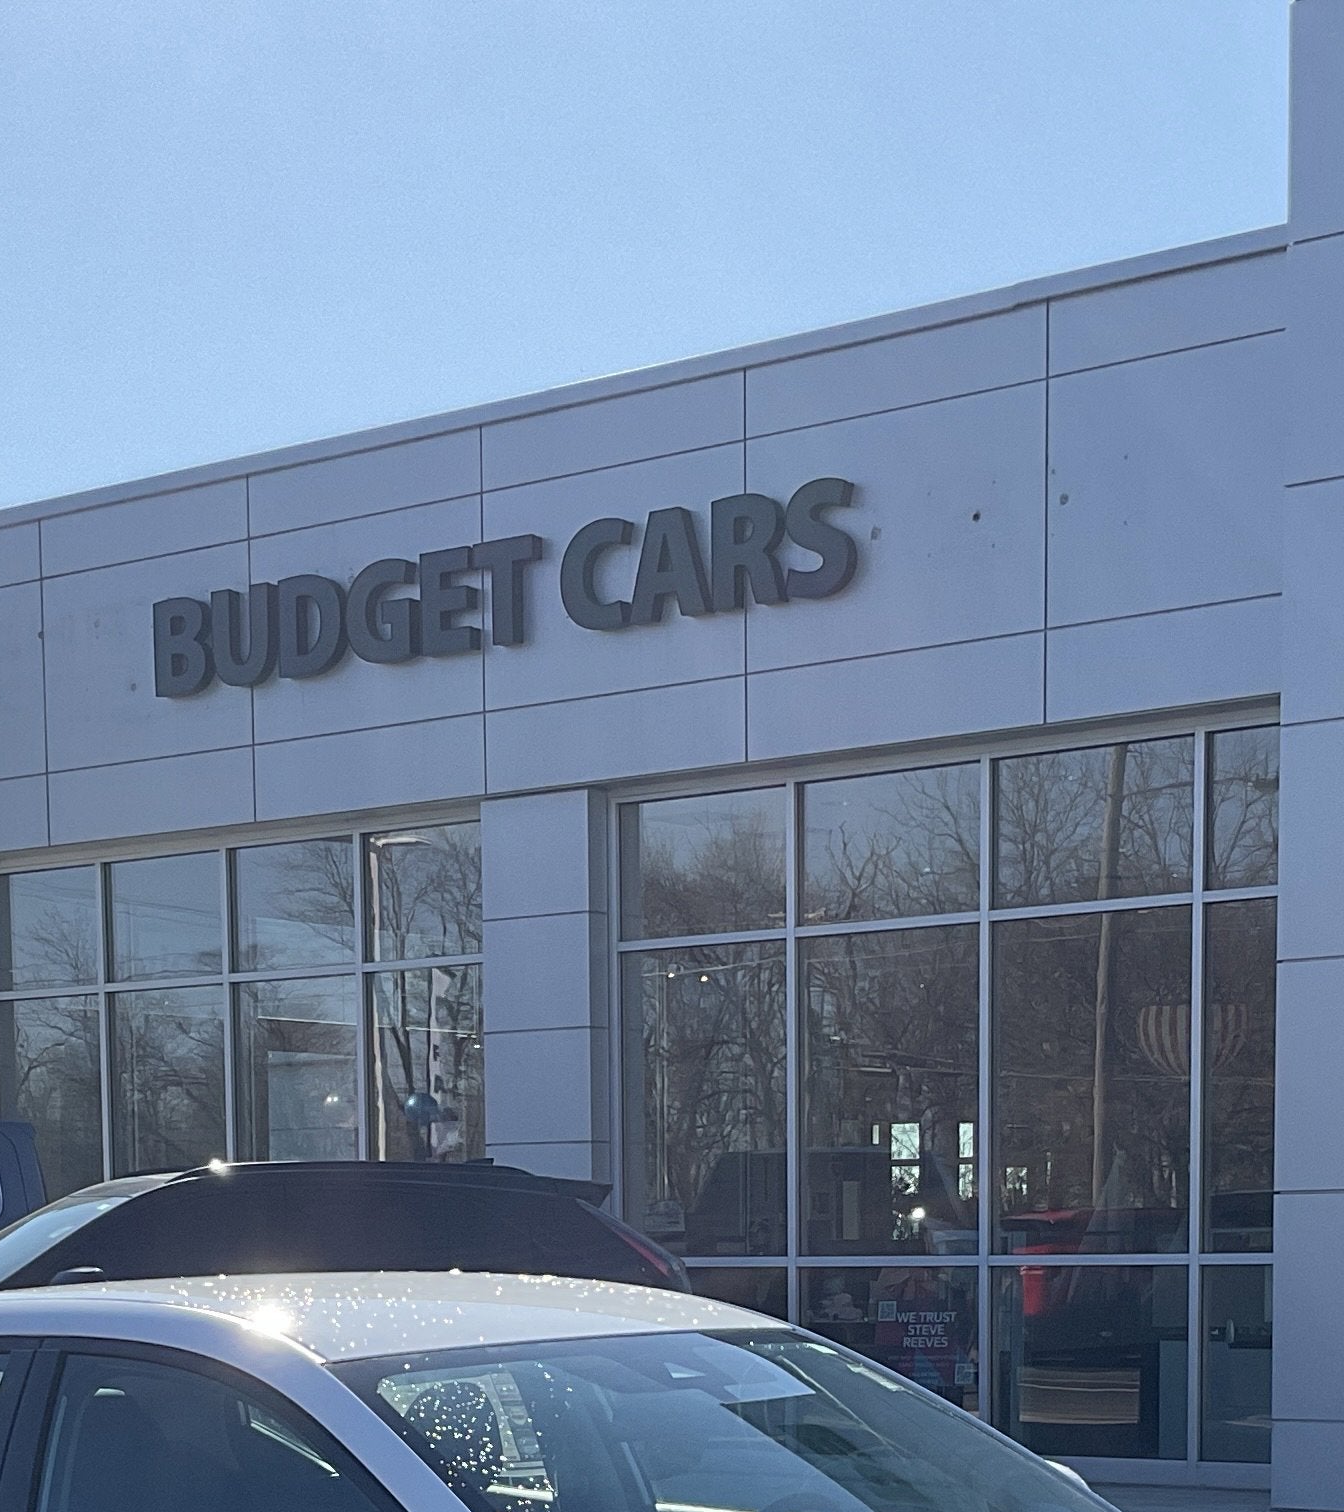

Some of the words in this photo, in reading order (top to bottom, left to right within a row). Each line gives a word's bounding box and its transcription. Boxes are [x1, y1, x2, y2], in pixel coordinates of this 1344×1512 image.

[153, 533, 542, 698] BUDGET
[560, 477, 857, 631] CARS
[896, 1311, 917, 1323] WE
[919, 1311, 957, 1323] TRUST
[907, 1324, 945, 1336] STEVE
[902, 1336, 949, 1348] REEVES
